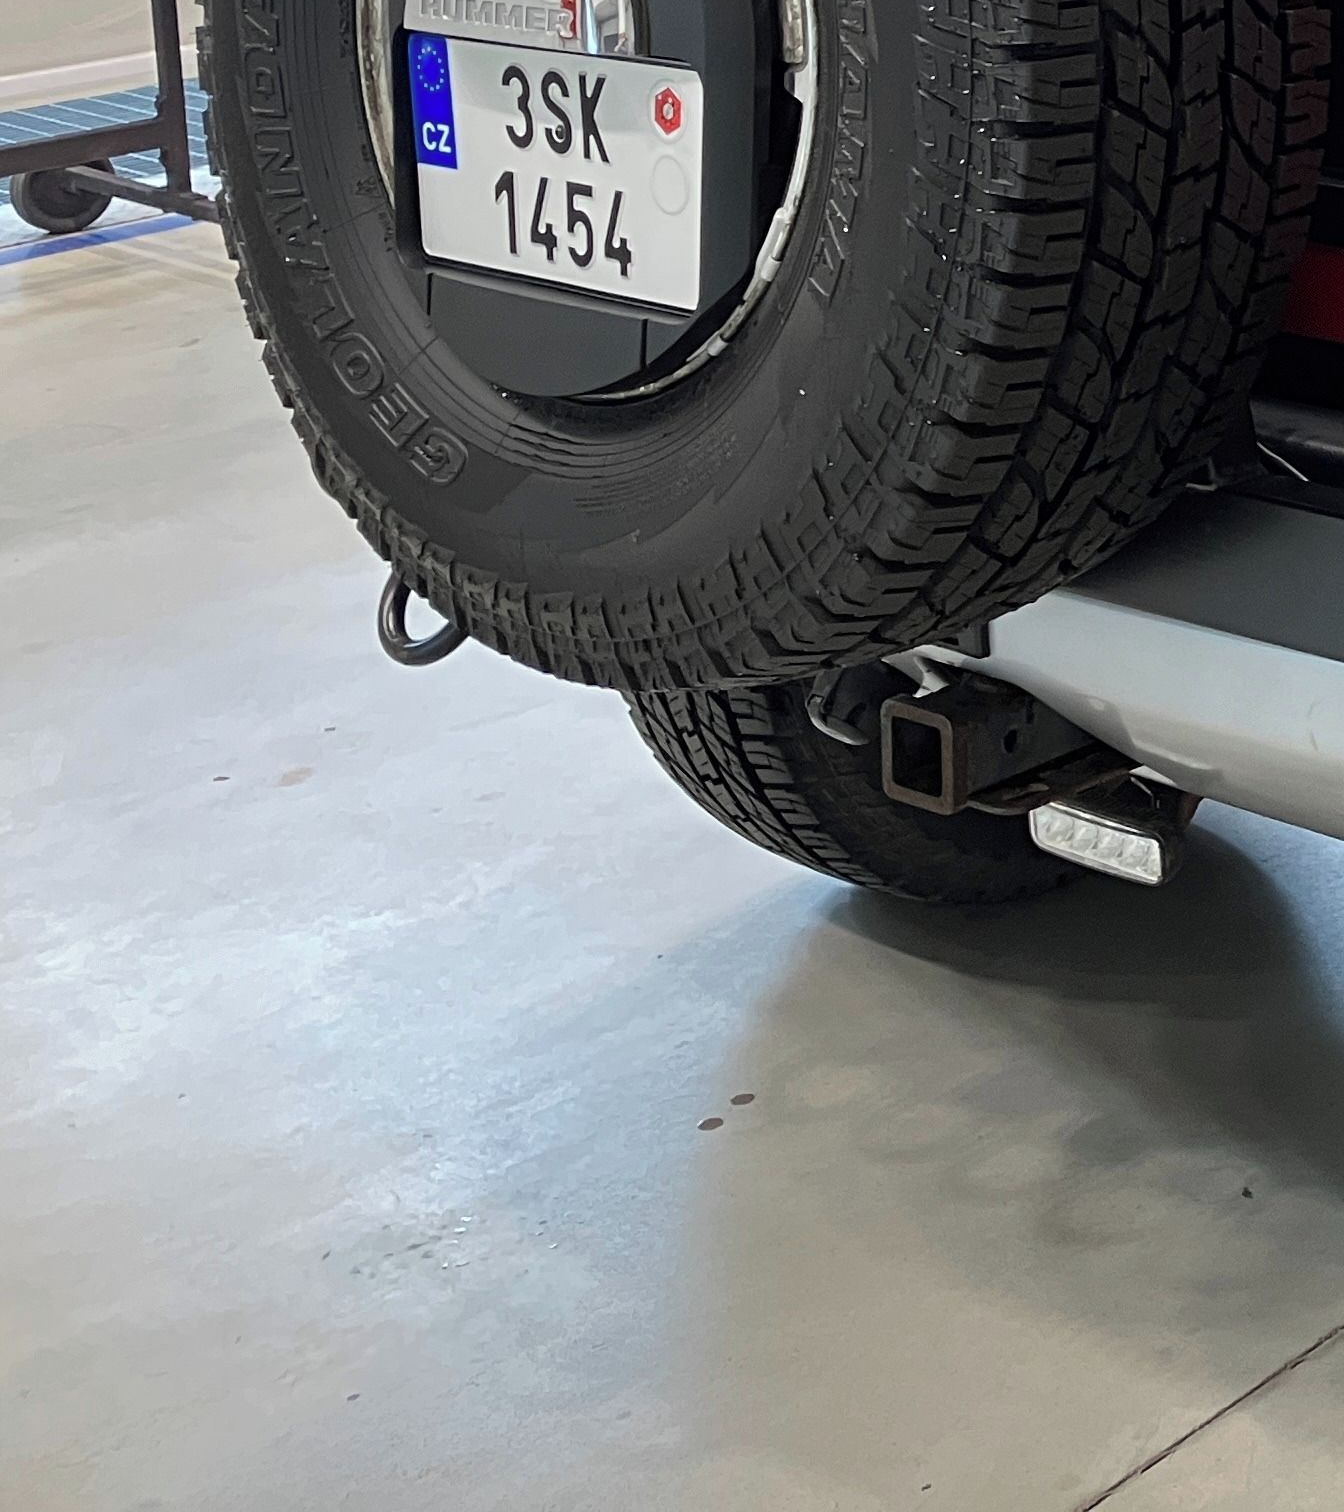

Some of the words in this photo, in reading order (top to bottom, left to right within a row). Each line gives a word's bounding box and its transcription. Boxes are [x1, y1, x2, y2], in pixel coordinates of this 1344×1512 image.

[421, 121, 452, 153] CZ
[501, 64, 611, 165] 3SK
[494, 170, 633, 278] 1454
